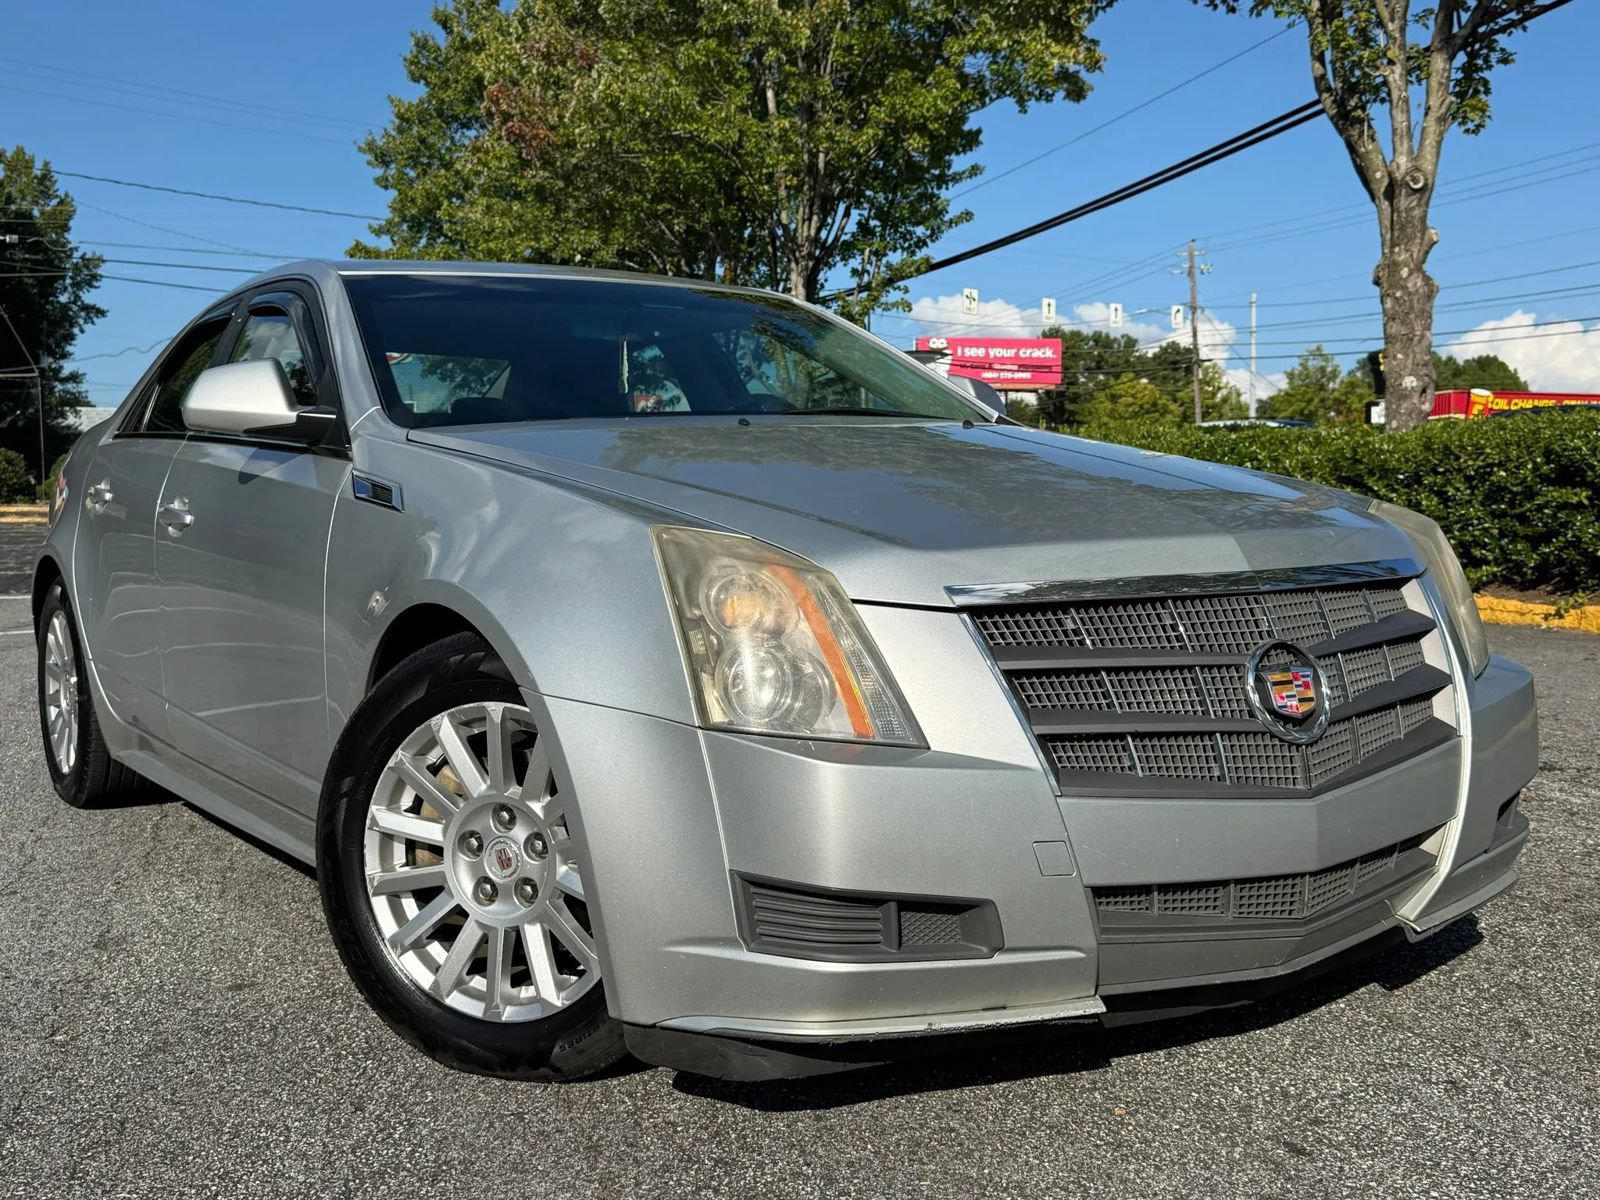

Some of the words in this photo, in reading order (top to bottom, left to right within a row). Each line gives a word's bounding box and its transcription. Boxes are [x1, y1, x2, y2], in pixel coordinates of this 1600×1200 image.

[957, 346, 962, 356] I
[963, 346, 986, 357] see
[988, 347, 1018, 359] your
[1018, 347, 1057, 359] crack.
[1493, 398, 1509, 410] OIL
